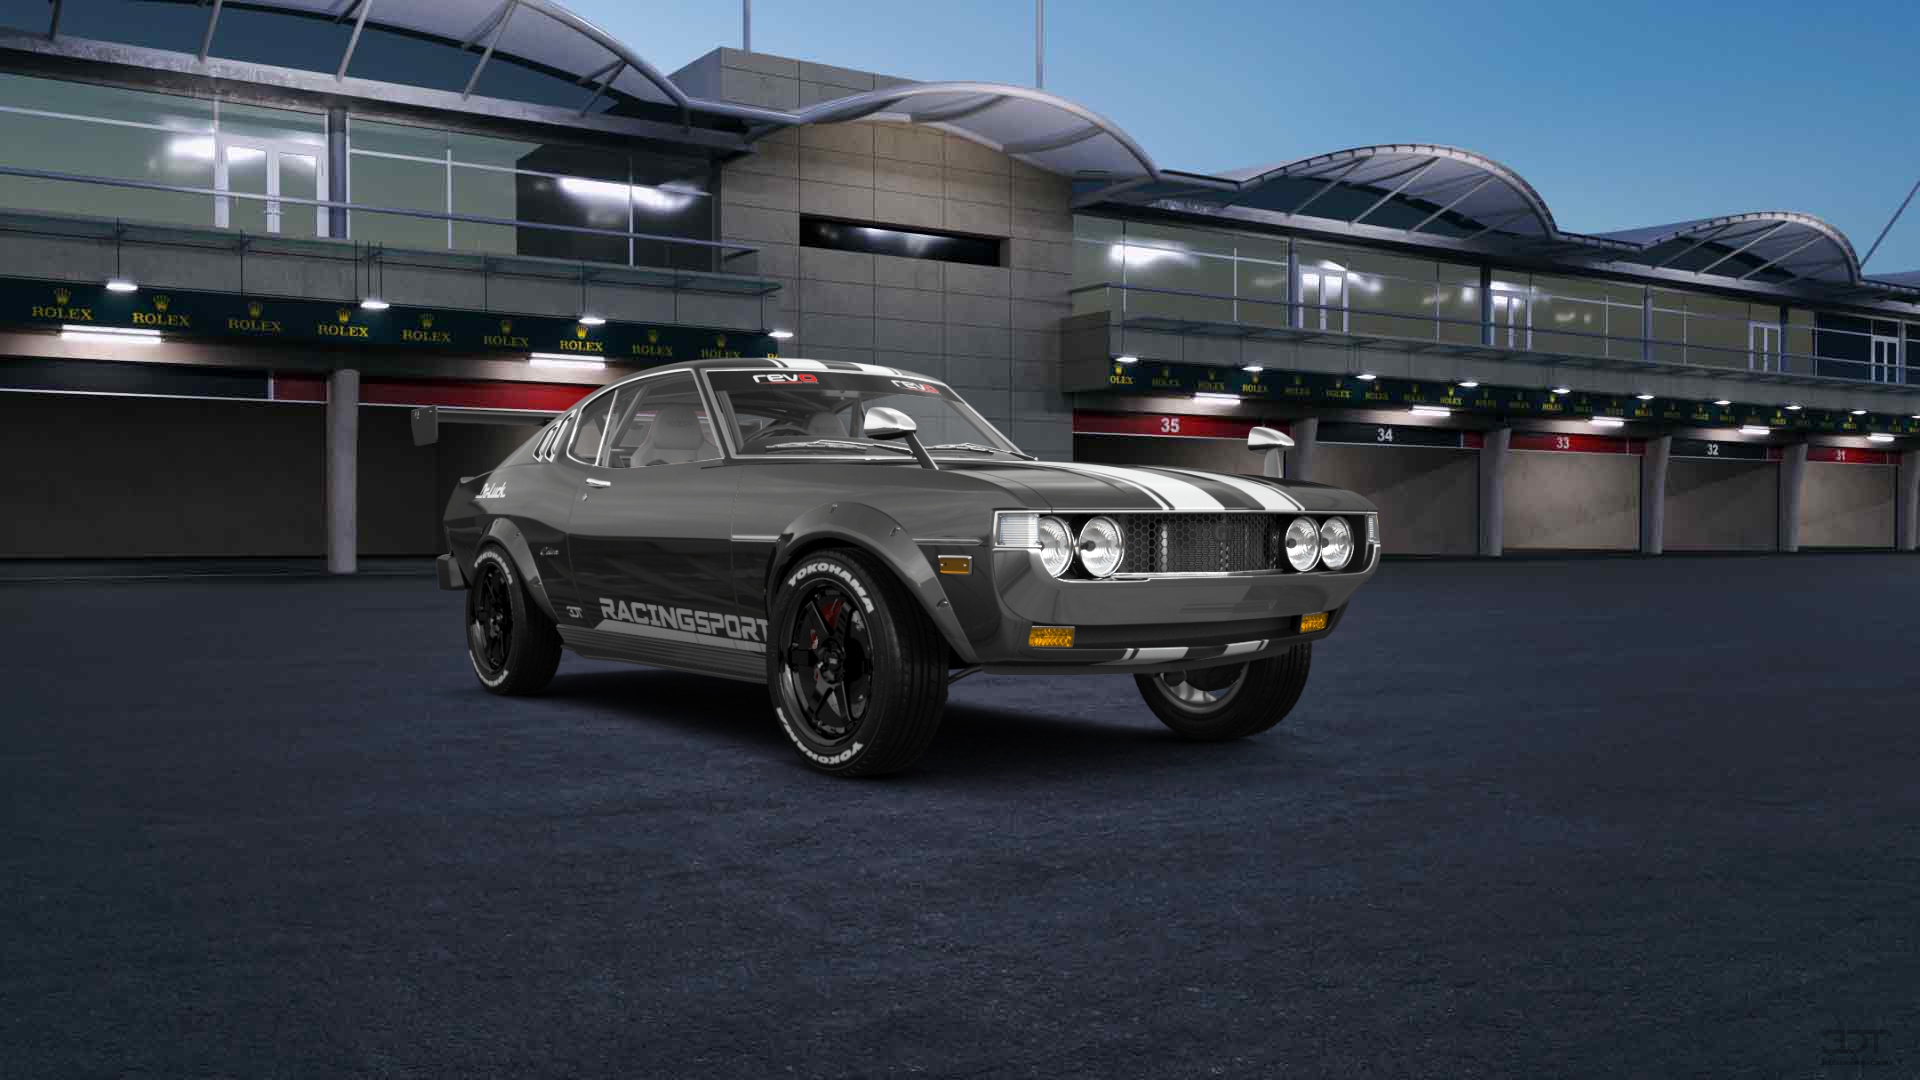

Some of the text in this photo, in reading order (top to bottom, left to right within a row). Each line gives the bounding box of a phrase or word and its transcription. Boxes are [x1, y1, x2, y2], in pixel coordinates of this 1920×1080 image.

[32, 306, 93, 321] ROLEX
[132, 312, 190, 327] ROLEX
[228, 319, 281, 333] ROLEX
[318, 323, 369, 337] ROLEX
[402, 329, 450, 342] ROLEX
[484, 335, 529, 347] ROLEX
[560, 339, 603, 352] ROLEX
[632, 344, 672, 356] ROLEX
[1160, 418, 1180, 433] 35
[1377, 428, 1393, 442] 34
[1556, 436, 1570, 450] 33
[1707, 443, 1719, 456] 32
[1214, 524, 1233, 540] GT
[474, 551, 513, 585] YOKOHAMA
[788, 562, 874, 614] YOKOHAMA
[776, 707, 864, 764] YOKOHAMA
